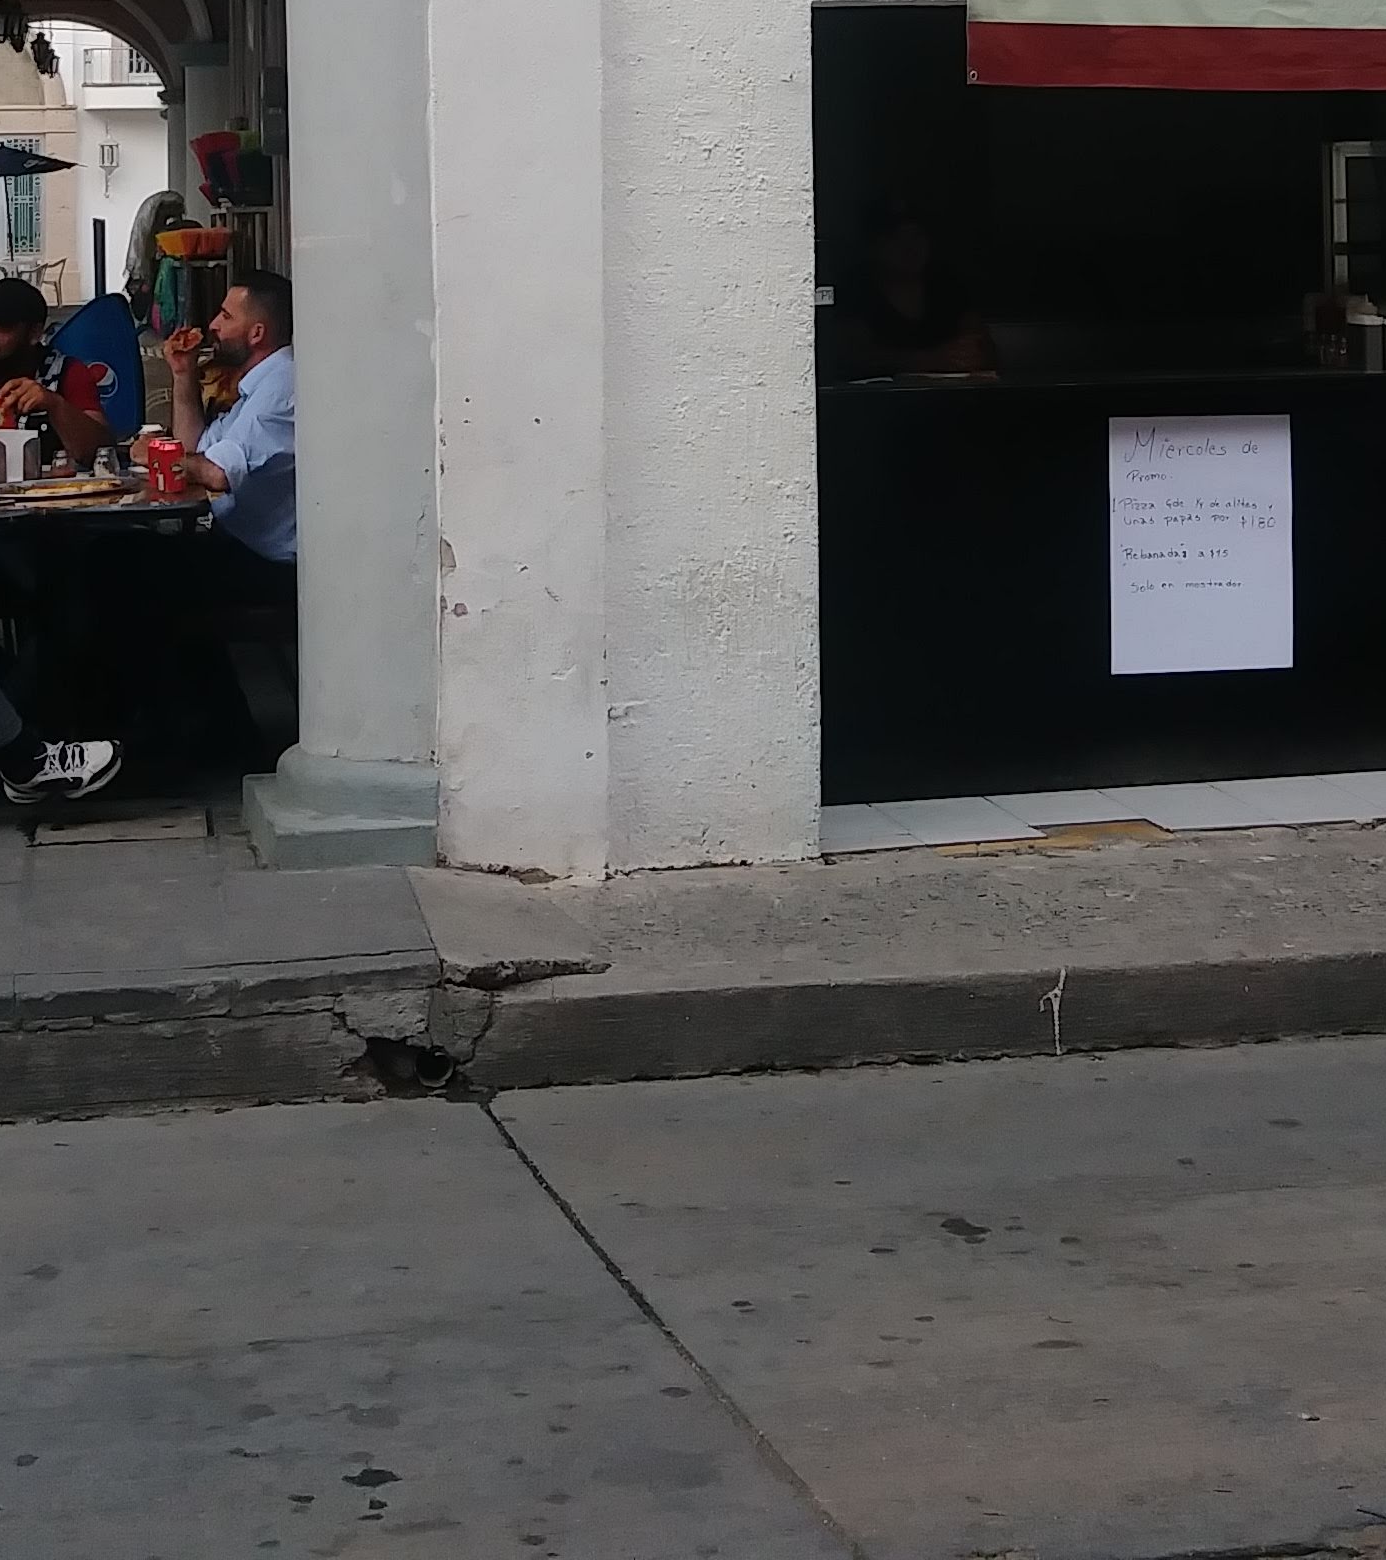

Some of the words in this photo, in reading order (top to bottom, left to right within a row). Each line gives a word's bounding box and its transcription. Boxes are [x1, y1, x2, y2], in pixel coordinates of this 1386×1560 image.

[1124, 426, 1227, 463] Miercoles
[1242, 440, 1261, 455] de
[1118, 497, 1156, 511] Pizza
